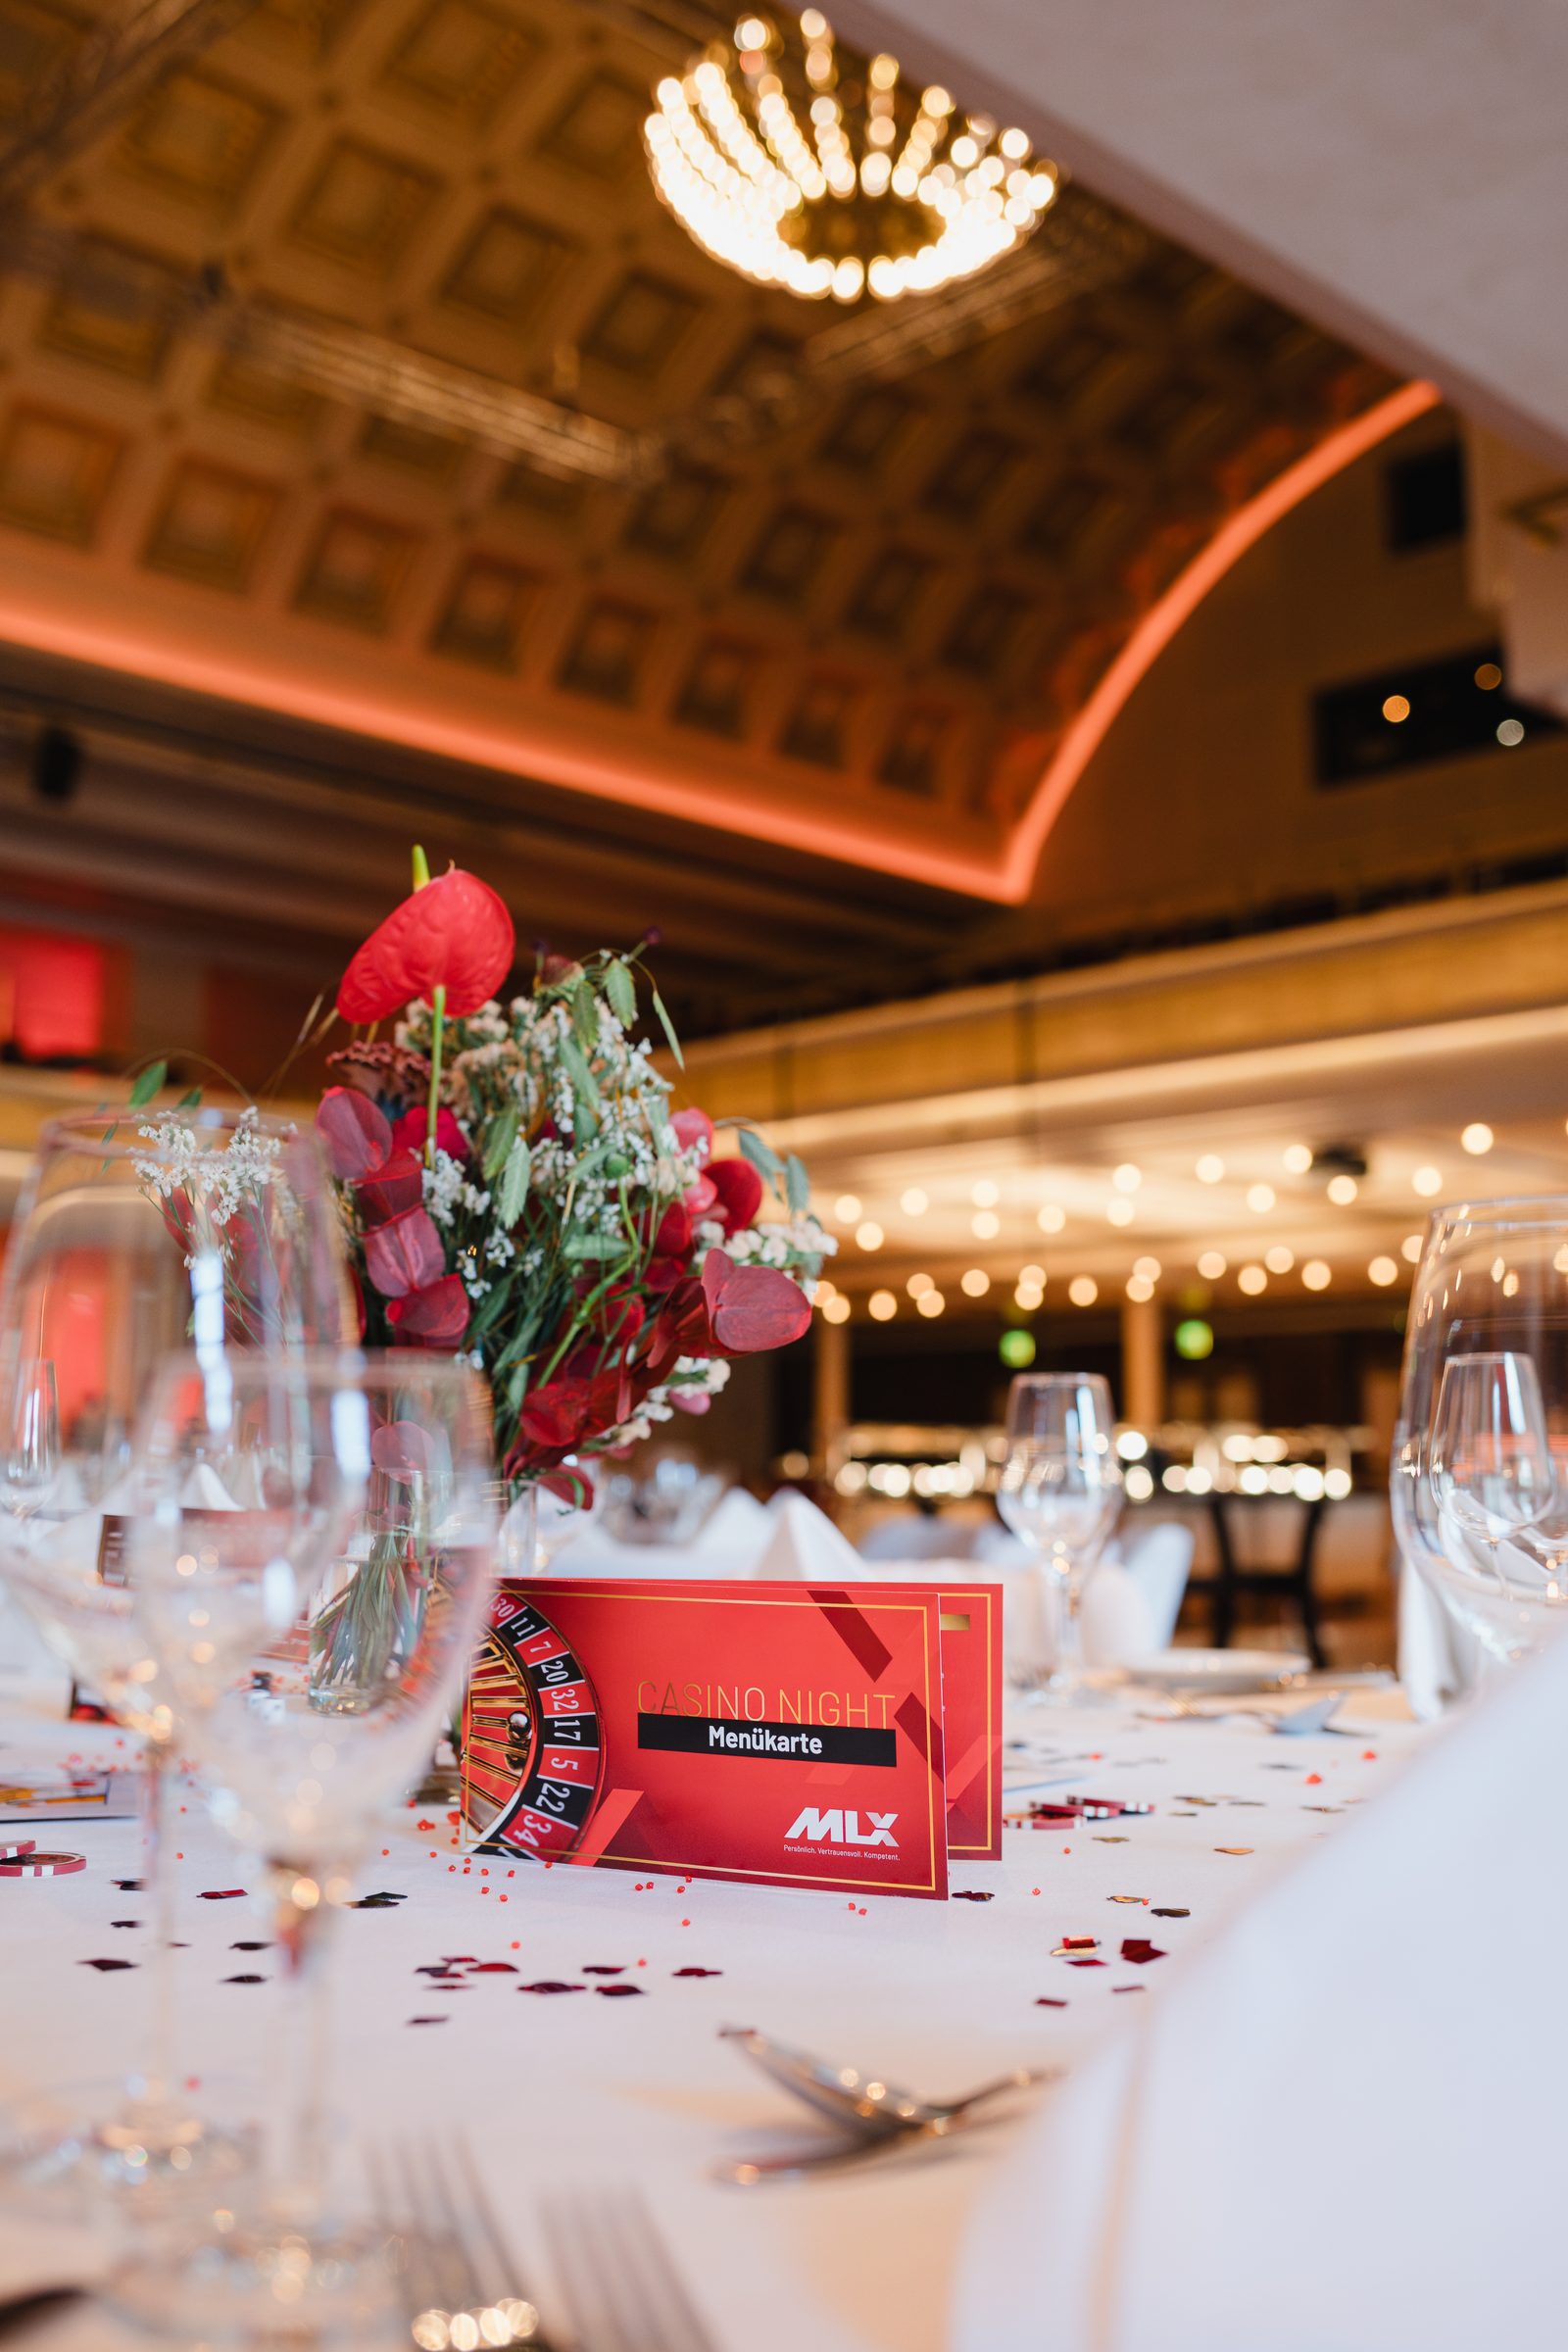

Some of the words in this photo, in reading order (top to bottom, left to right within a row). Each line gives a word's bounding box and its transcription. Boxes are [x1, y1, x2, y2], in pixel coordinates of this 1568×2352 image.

[491, 1597, 514, 1618] 30
[511, 1616, 537, 1638] 11
[529, 1641, 553, 1653] 7
[540, 1660, 569, 1683] 20
[551, 1689, 579, 1711] 32
[637, 1681, 765, 1721] CASINO
[779, 1689, 896, 1730] NIGHT
[554, 1719, 581, 1741] 17
[709, 1726, 823, 1755] Menükarte
[551, 1757, 579, 1771] 5
[535, 1783, 571, 1813] 22
[514, 1813, 551, 1847] 34
[784, 1806, 900, 1847] MLX
[783, 1843, 817, 1855] Persönlich.
[816, 1847, 863, 1859] Vertrauensvoll.
[863, 1851, 901, 1862] Kompetent.
